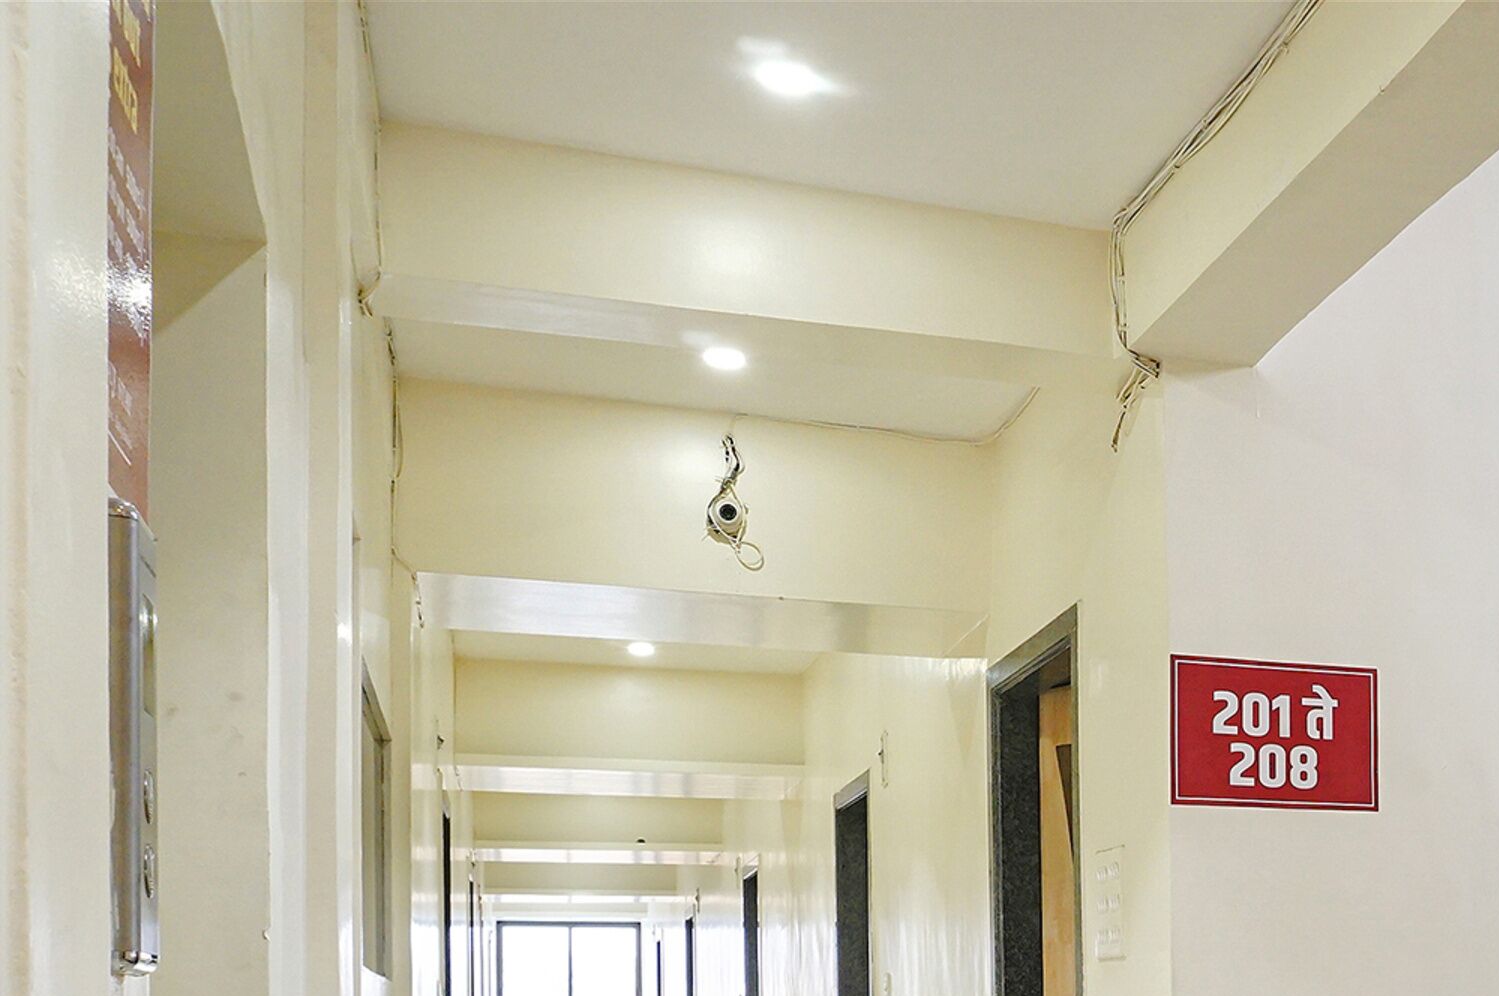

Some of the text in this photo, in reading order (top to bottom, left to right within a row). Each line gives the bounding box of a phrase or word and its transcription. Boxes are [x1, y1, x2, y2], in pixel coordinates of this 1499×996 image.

[1212, 684, 1339, 740] 201 ते
[1229, 742, 1318, 790] 208
